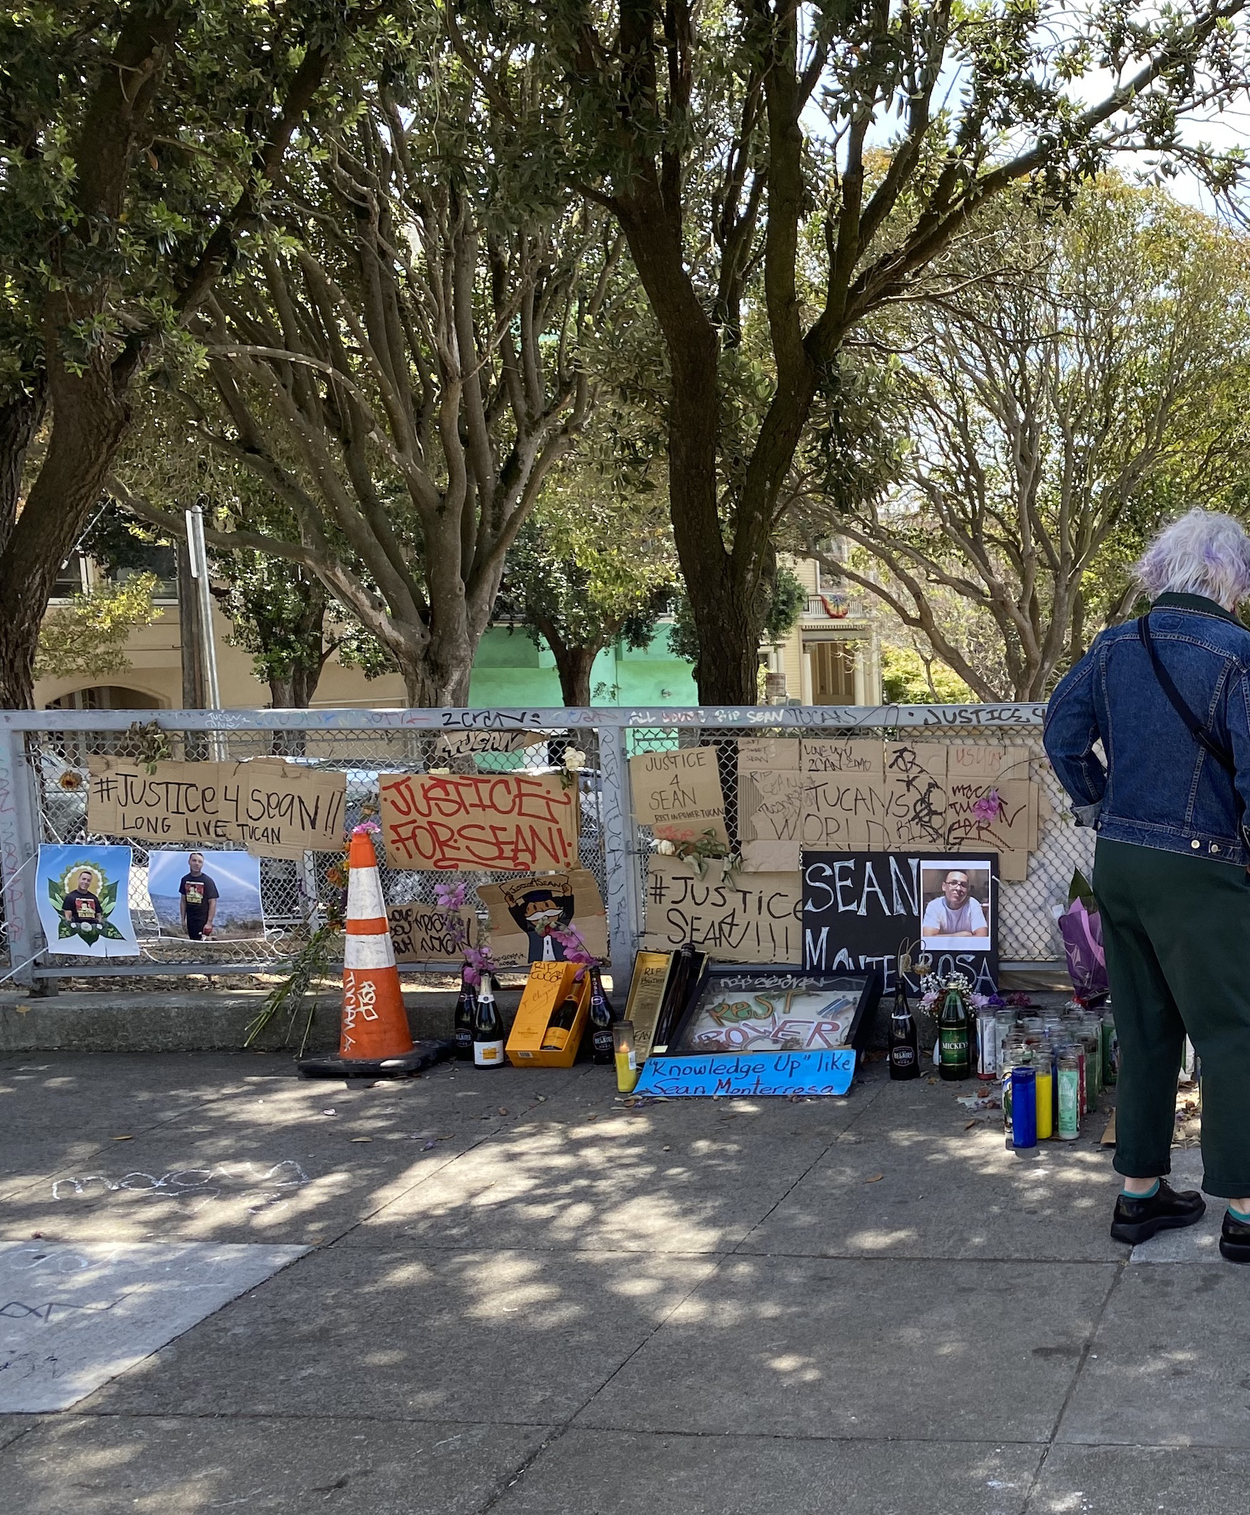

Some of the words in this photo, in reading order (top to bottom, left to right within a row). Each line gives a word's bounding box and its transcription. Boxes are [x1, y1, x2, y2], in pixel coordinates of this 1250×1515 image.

[746, 708, 785, 723] SEAN
[924, 708, 1030, 726] JUSTICE
[645, 752, 706, 772] JUSTICE
[669, 774, 682, 791] 4
[224, 785, 240, 822] 4
[382, 775, 571, 824] JUSTICE
[649, 787, 697, 811] SEAN
[122, 813, 172, 833] LONG
[186, 819, 232, 838] LIVE
[390, 819, 460, 861] FOR
[803, 855, 920, 917] SEAN
[534, 961, 558, 971] RIP
[649, 1077, 706, 1095] Sean
[714, 1075, 835, 1095] Monterrosa
